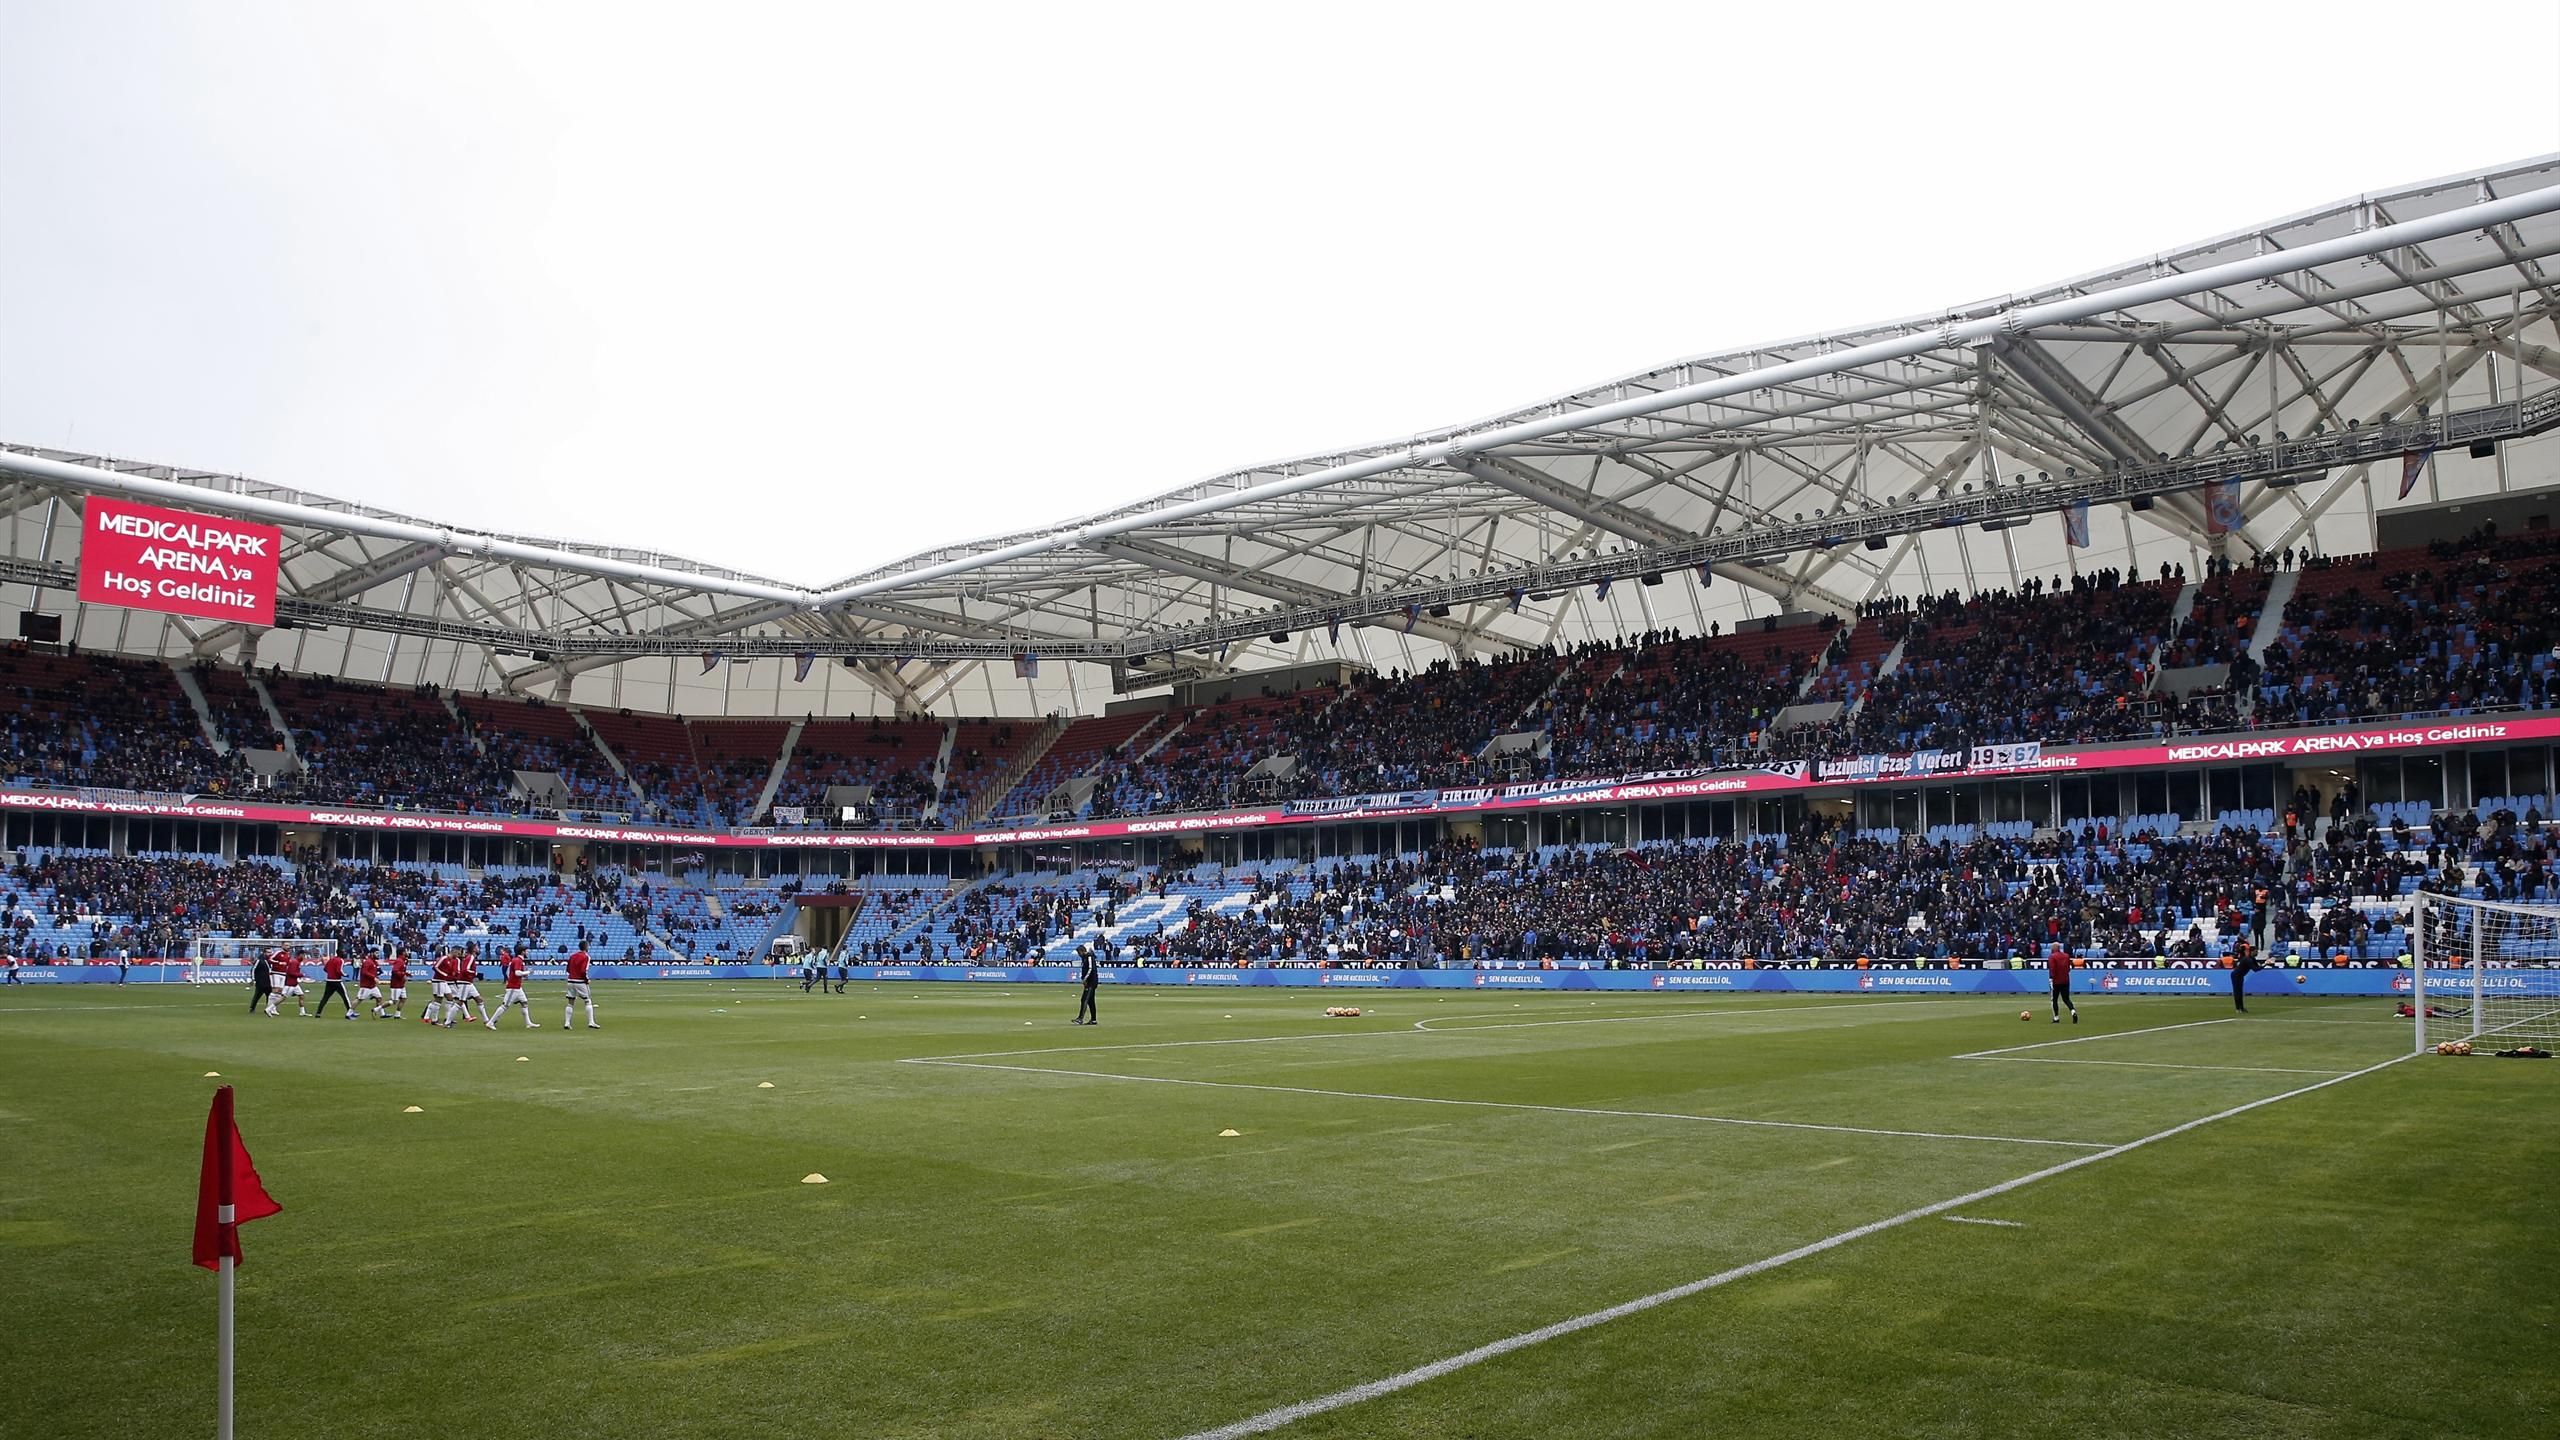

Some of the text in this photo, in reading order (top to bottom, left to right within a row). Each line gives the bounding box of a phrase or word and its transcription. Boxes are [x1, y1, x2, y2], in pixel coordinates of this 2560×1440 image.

[100, 511, 269, 557] MEDICALPARK
[104, 570, 256, 609] Hoş Geldiniz
[2168, 739, 2286, 760] MEDICALPARK
[2389, 731, 2424, 745] Hoş
[2427, 725, 2507, 741] Geldiniz
[1676, 782, 1698, 793] Hoş
[1699, 780, 1747, 790] Geldiniz
[196, 806, 245, 818] Geldiniz
[310, 812, 386, 826] MEDICALPARK
[443, 820, 463, 831] Hoş
[464, 821, 504, 831] Geldiniz
[1127, 820, 1178, 832] MEDICALPARK
[1234, 814, 1266, 824] Geldiniz
[556, 826, 619, 840] MEDICALPARK
[683, 834, 717, 844] Geldiniz
[767, 835, 831, 846] MEDICALPARK
[899, 836, 935, 845] Geldiniz
[1878, 977, 1894, 985] SEN
[1894, 977, 1905, 985] DE
[2124, 977, 2142, 986] SEN
[2143, 977, 2155, 986] DE
[2443, 978, 2457, 987] DE
